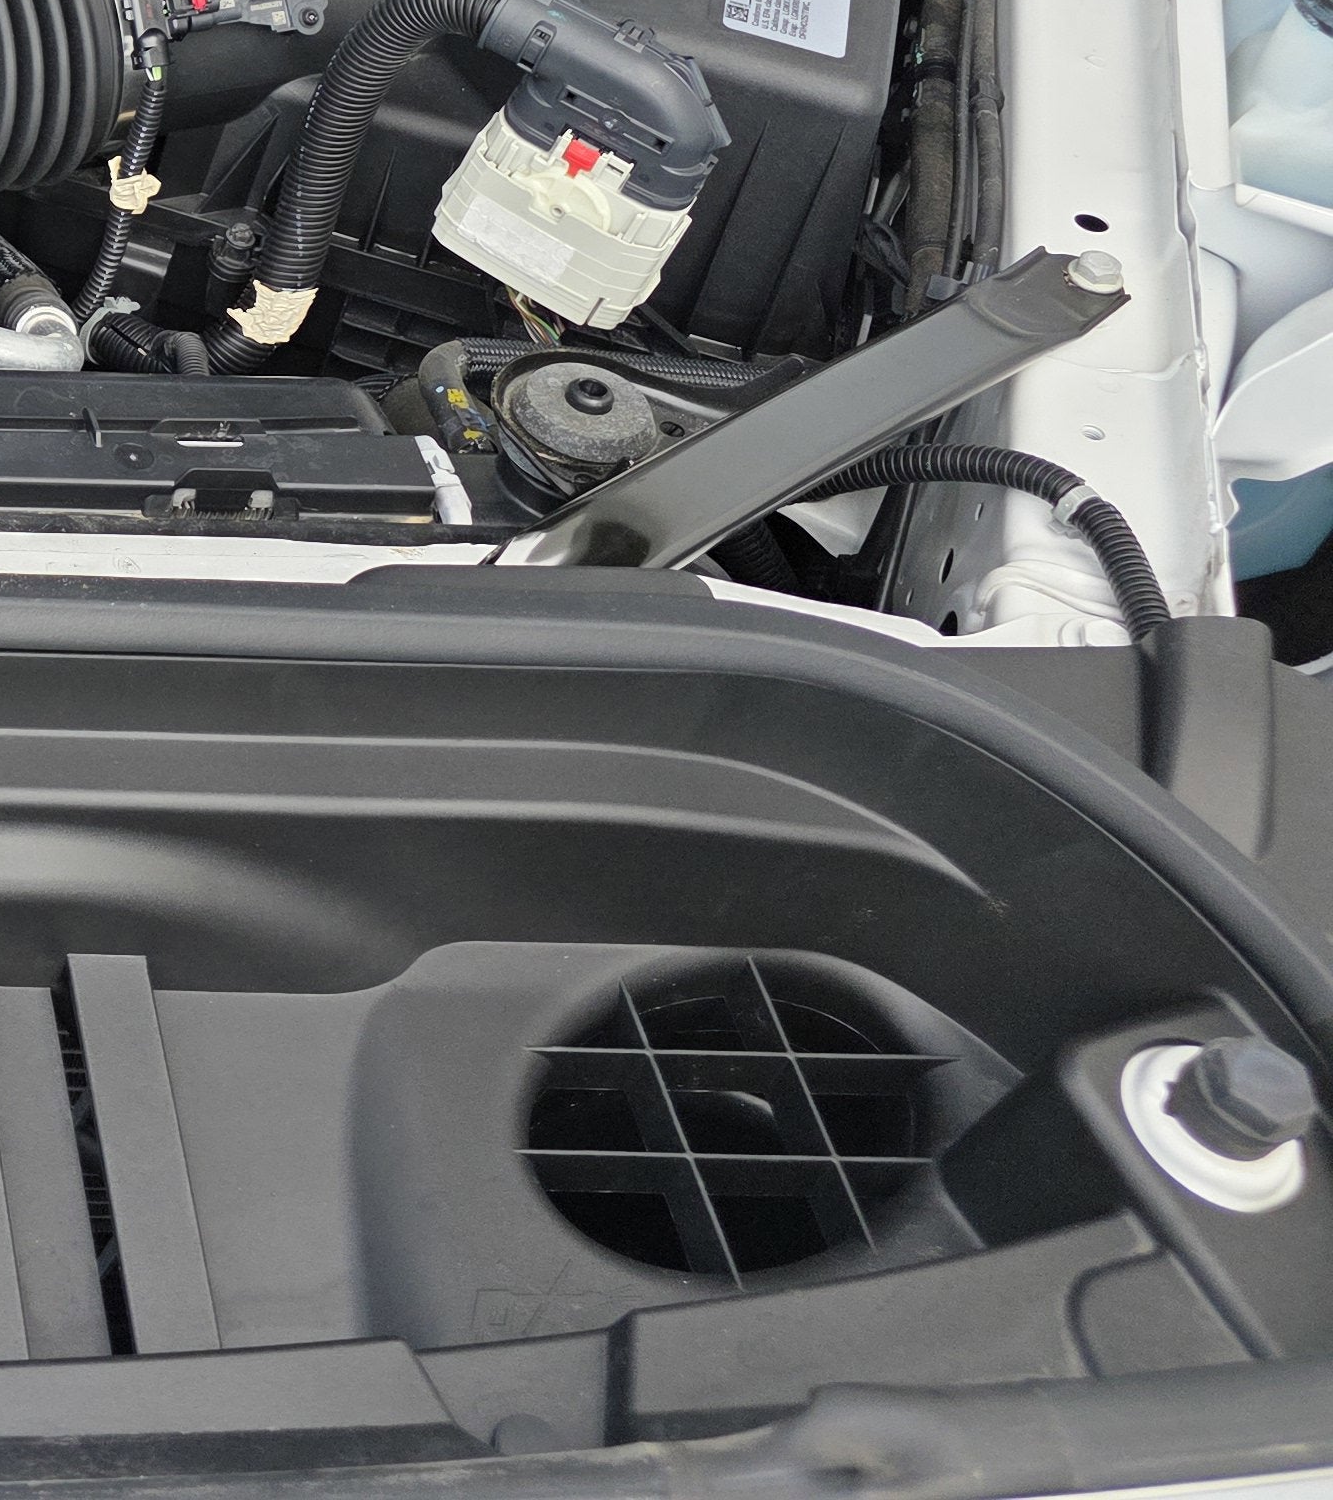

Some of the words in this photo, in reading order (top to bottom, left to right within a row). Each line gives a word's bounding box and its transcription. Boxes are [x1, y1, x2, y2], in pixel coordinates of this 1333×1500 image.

[751, 2, 761, 27] Conforms
[762, 7, 771, 18] EPA
[770, 7, 780, 32] California
[761, 18, 769, 29] U.S.
